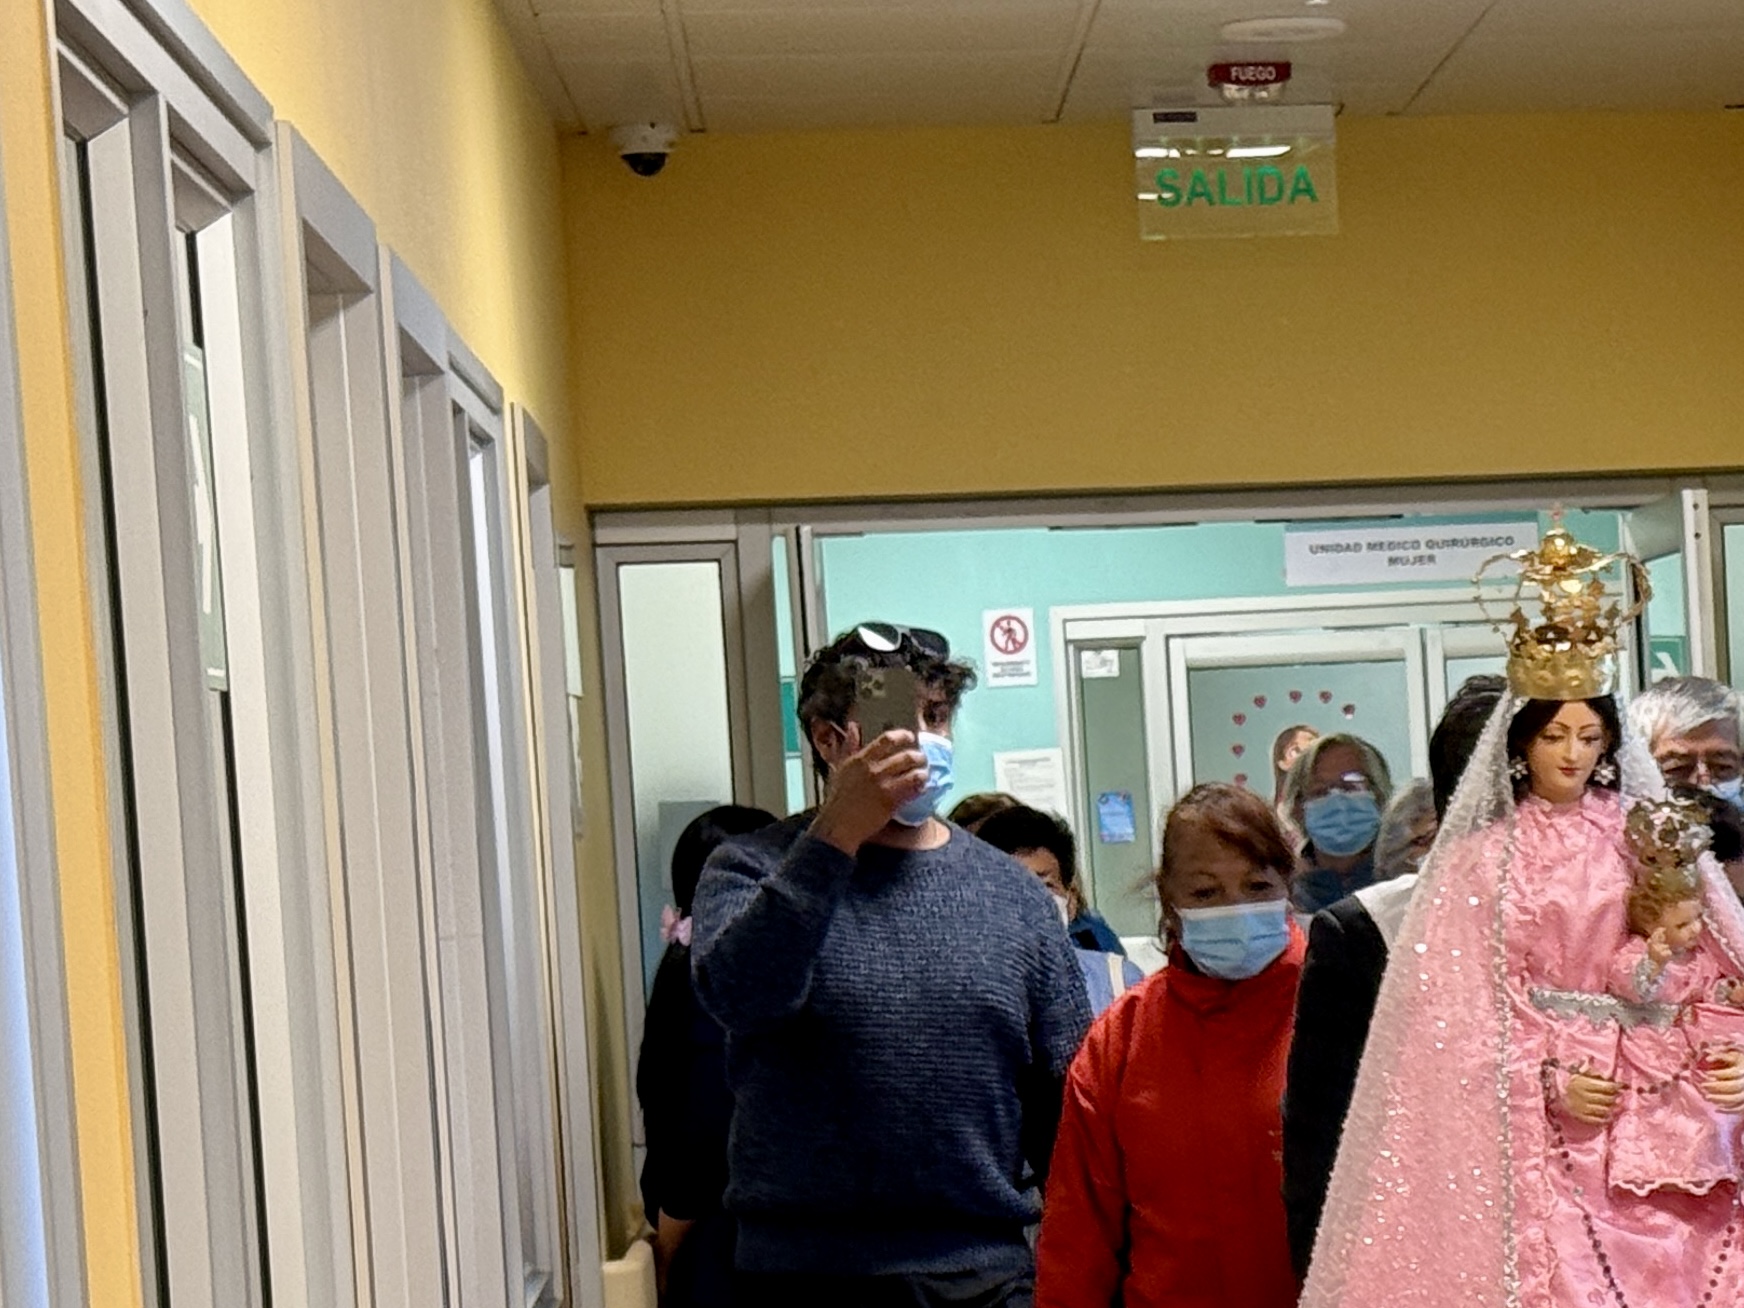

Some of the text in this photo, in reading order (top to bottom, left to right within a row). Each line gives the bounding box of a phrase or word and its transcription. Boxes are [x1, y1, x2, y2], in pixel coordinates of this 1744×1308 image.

[1230, 66, 1276, 81] FUEGO
[1156, 166, 1318, 207] SALIDA
[1309, 543, 1362, 555] UNIDAD
[1387, 554, 1437, 567] MUJER
